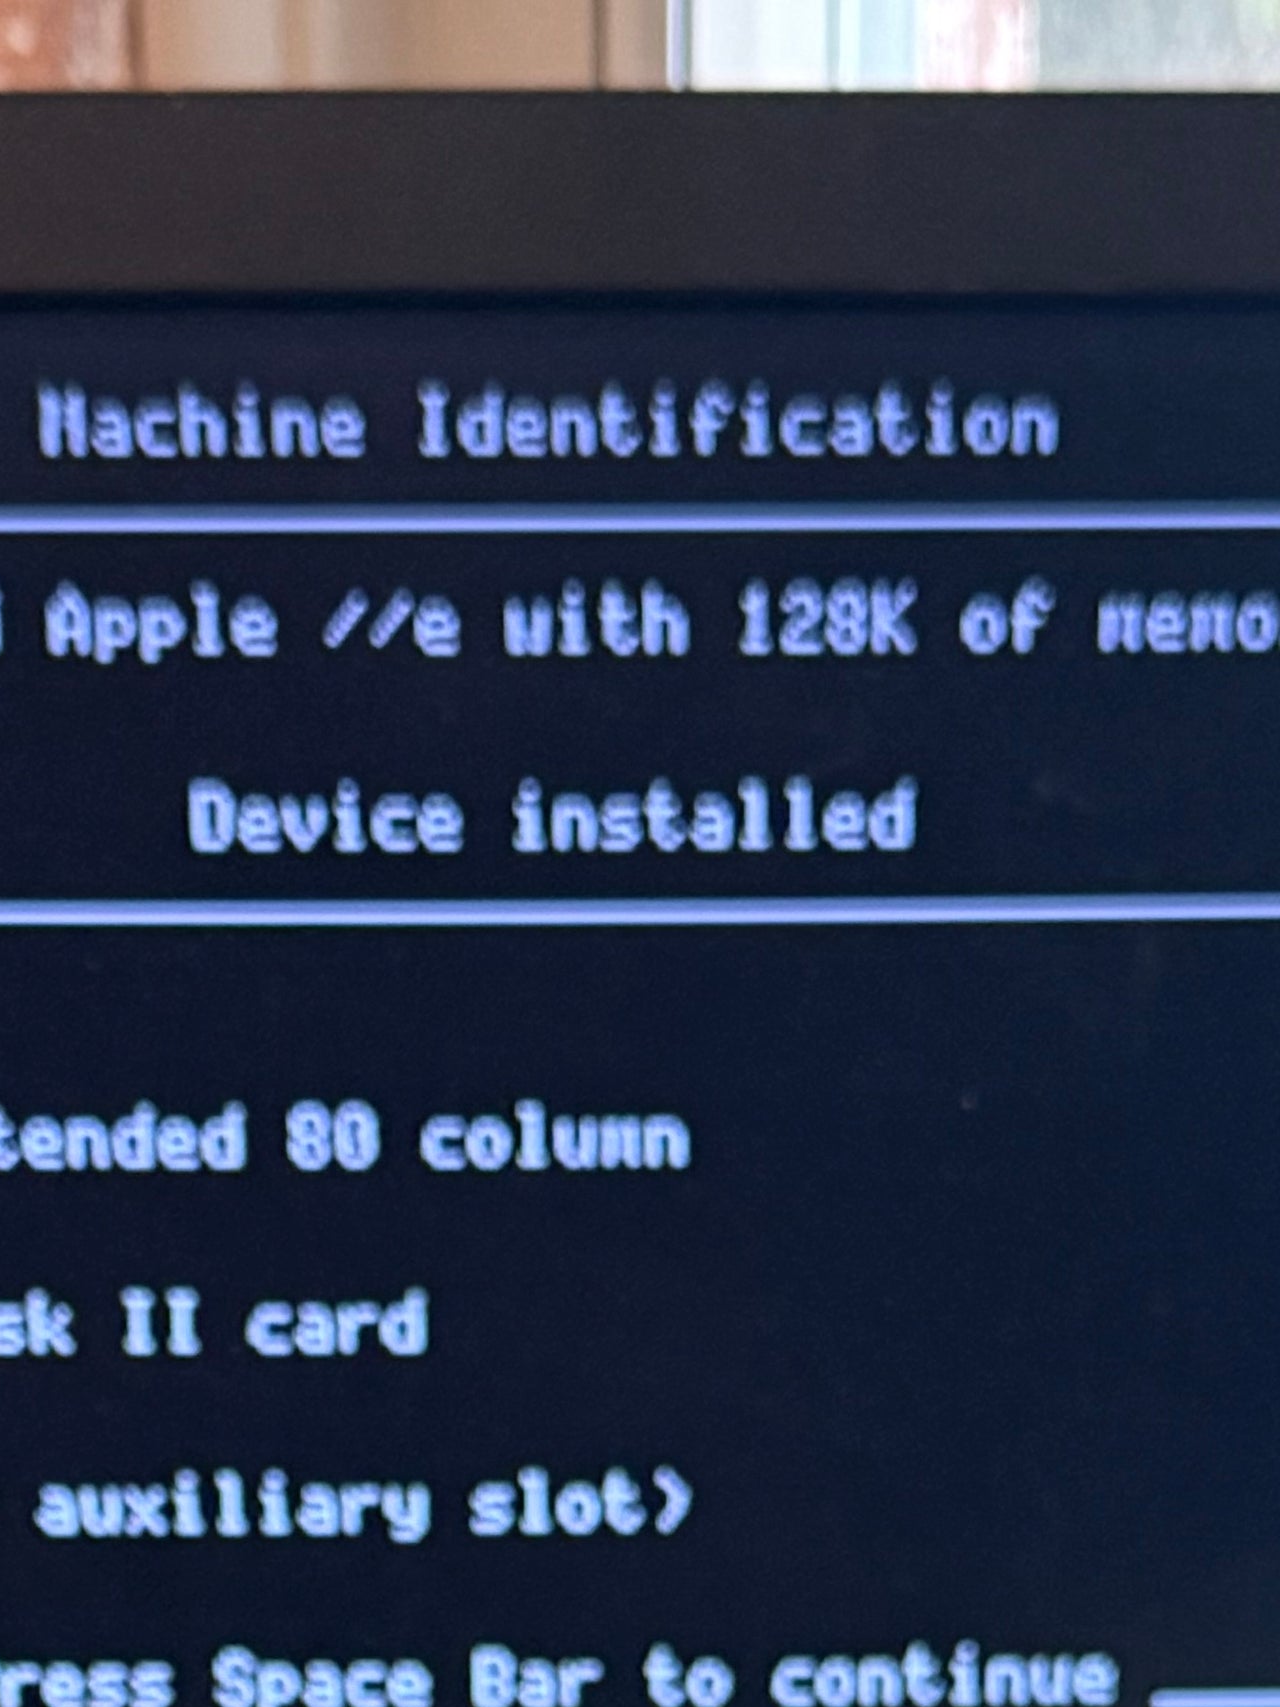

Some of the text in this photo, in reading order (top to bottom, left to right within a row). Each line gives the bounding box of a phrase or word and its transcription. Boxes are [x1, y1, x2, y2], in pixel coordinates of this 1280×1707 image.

[37, 382, 1060, 459] Machine Identification
[43, 580, 279, 666] Apple
[322, 587, 462, 658] //e
[502, 582, 691, 658] with
[739, 578, 918, 657] 128K
[958, 578, 1057, 656] of
[187, 774, 918, 855] Device installed
[284, 1098, 382, 1173] 80
[419, 1098, 692, 1172] column
[120, 1285, 202, 1358] II
[244, 1286, 429, 1358] card
[33, 1466, 432, 1545] auxiliary
[468, 1466, 693, 1538] slot)
